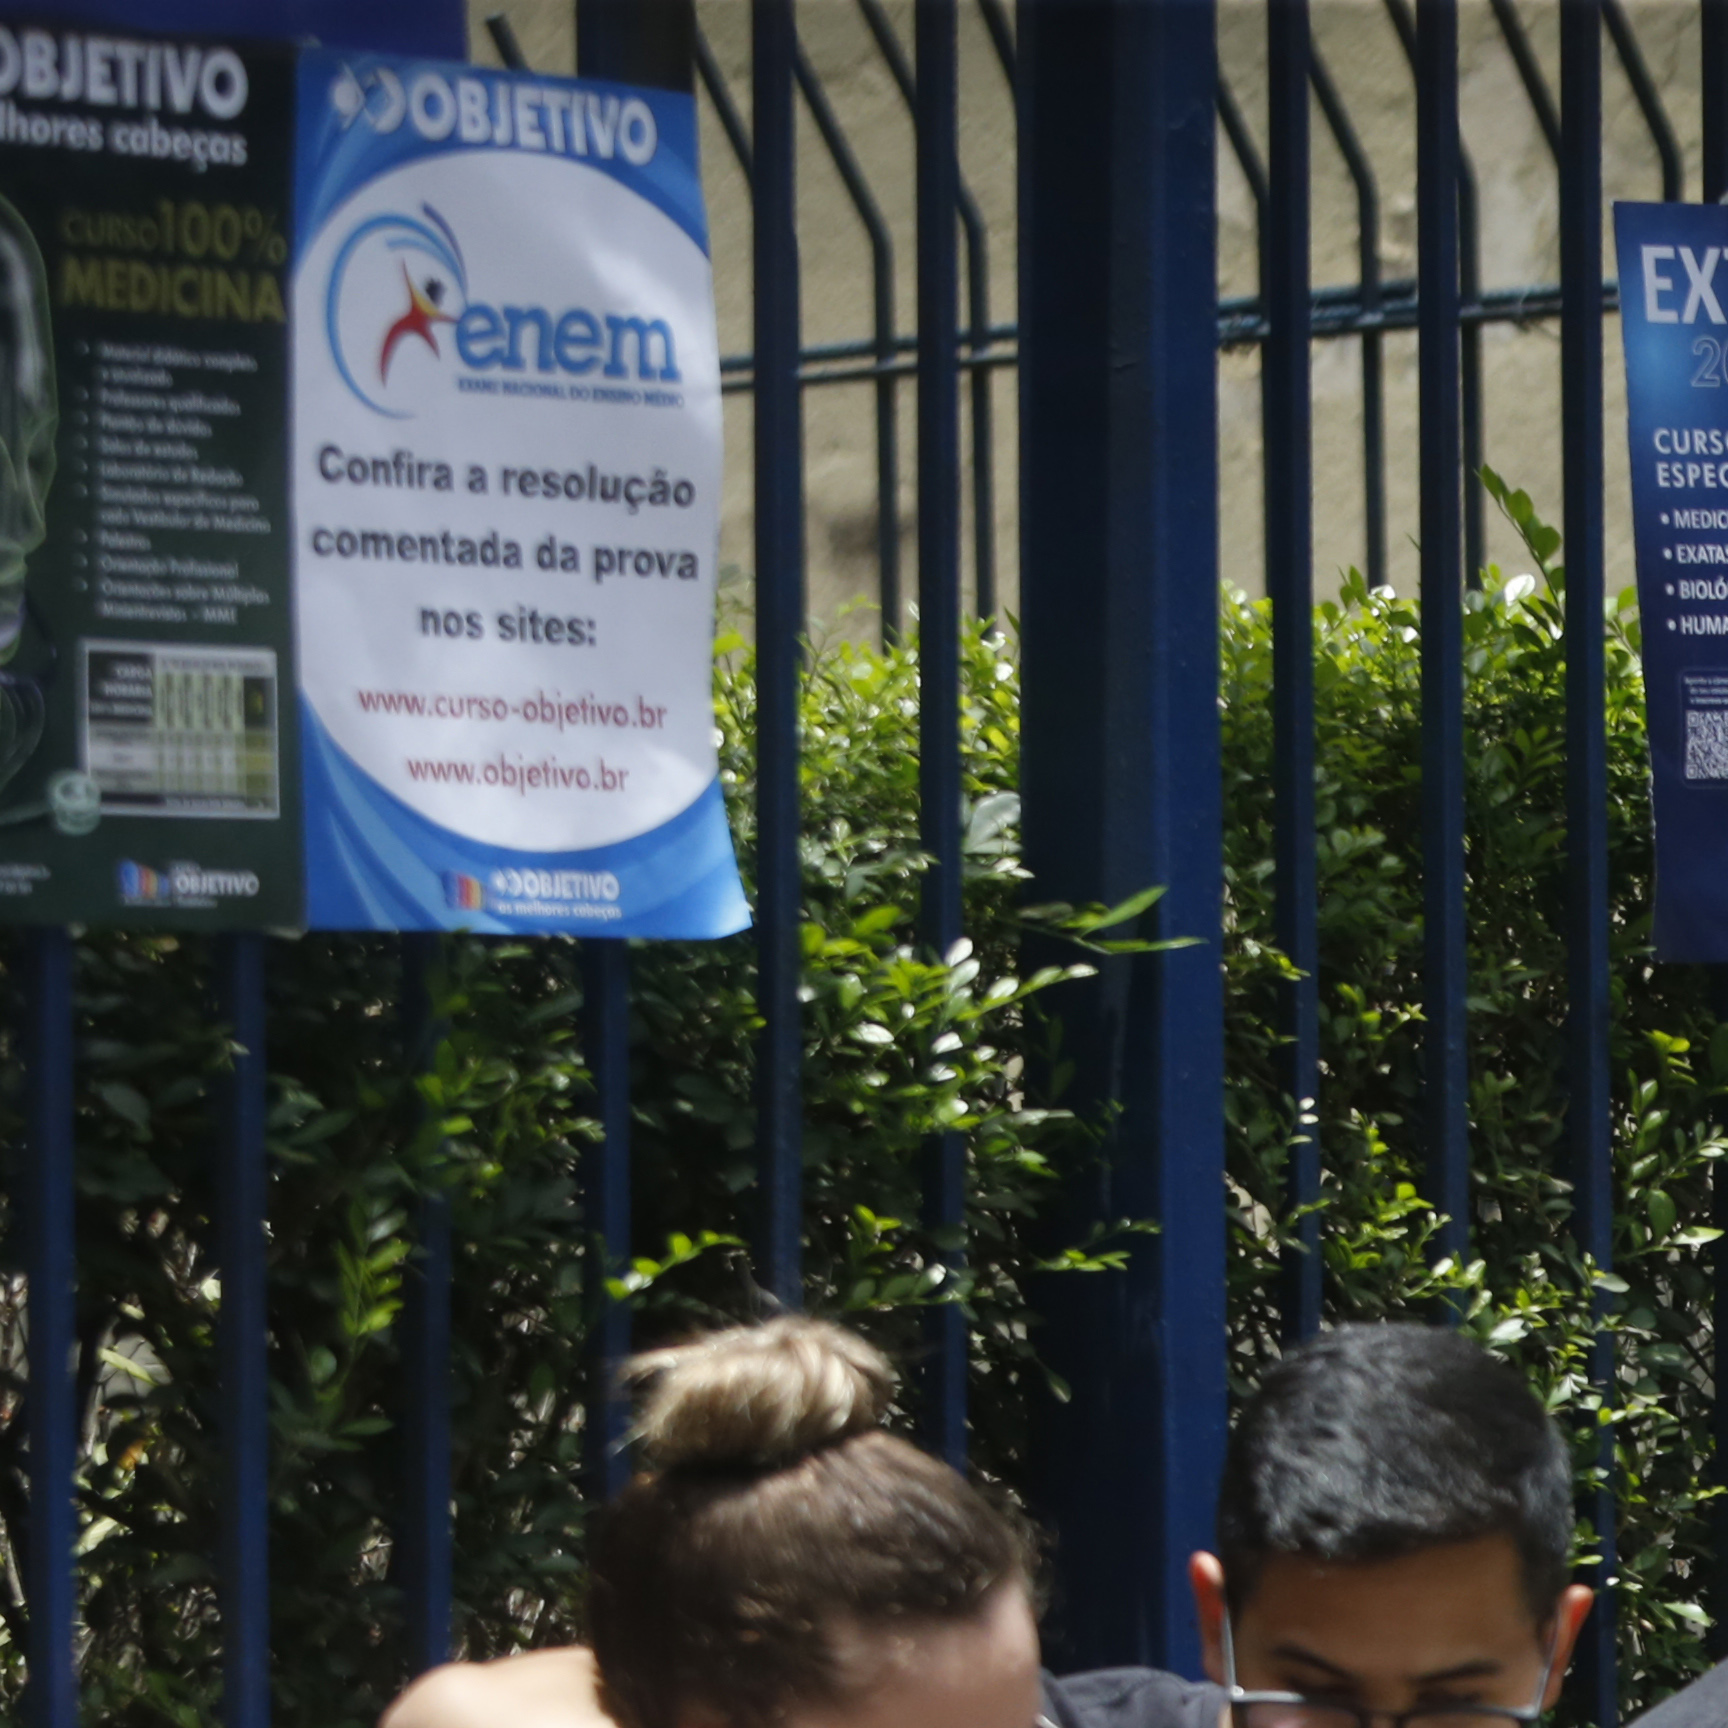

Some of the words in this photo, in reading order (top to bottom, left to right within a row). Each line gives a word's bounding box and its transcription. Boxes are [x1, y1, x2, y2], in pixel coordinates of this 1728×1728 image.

[112, 114, 248, 172] cabeças
[410, 73, 659, 167] OBJETIVO
[60, 207, 159, 252] CURSO
[160, 200, 288, 265] 100%
[62, 256, 288, 323] MEDICINA
[454, 301, 682, 383] enem
[318, 444, 454, 493] Confira
[467, 461, 489, 495] a
[503, 459, 696, 515] resolução
[311, 523, 522, 570] comentada
[536, 529, 581, 573] da
[592, 541, 699, 583] prova
[420, 604, 484, 640] nos
[498, 605, 597, 647] sites:
[358, 687, 669, 733] www.curso-objetivo.br
[407, 753, 629, 797] www.objetivo.br
[174, 870, 260, 897] OBJETIVO
[522, 868, 621, 902] OBJETIVO
